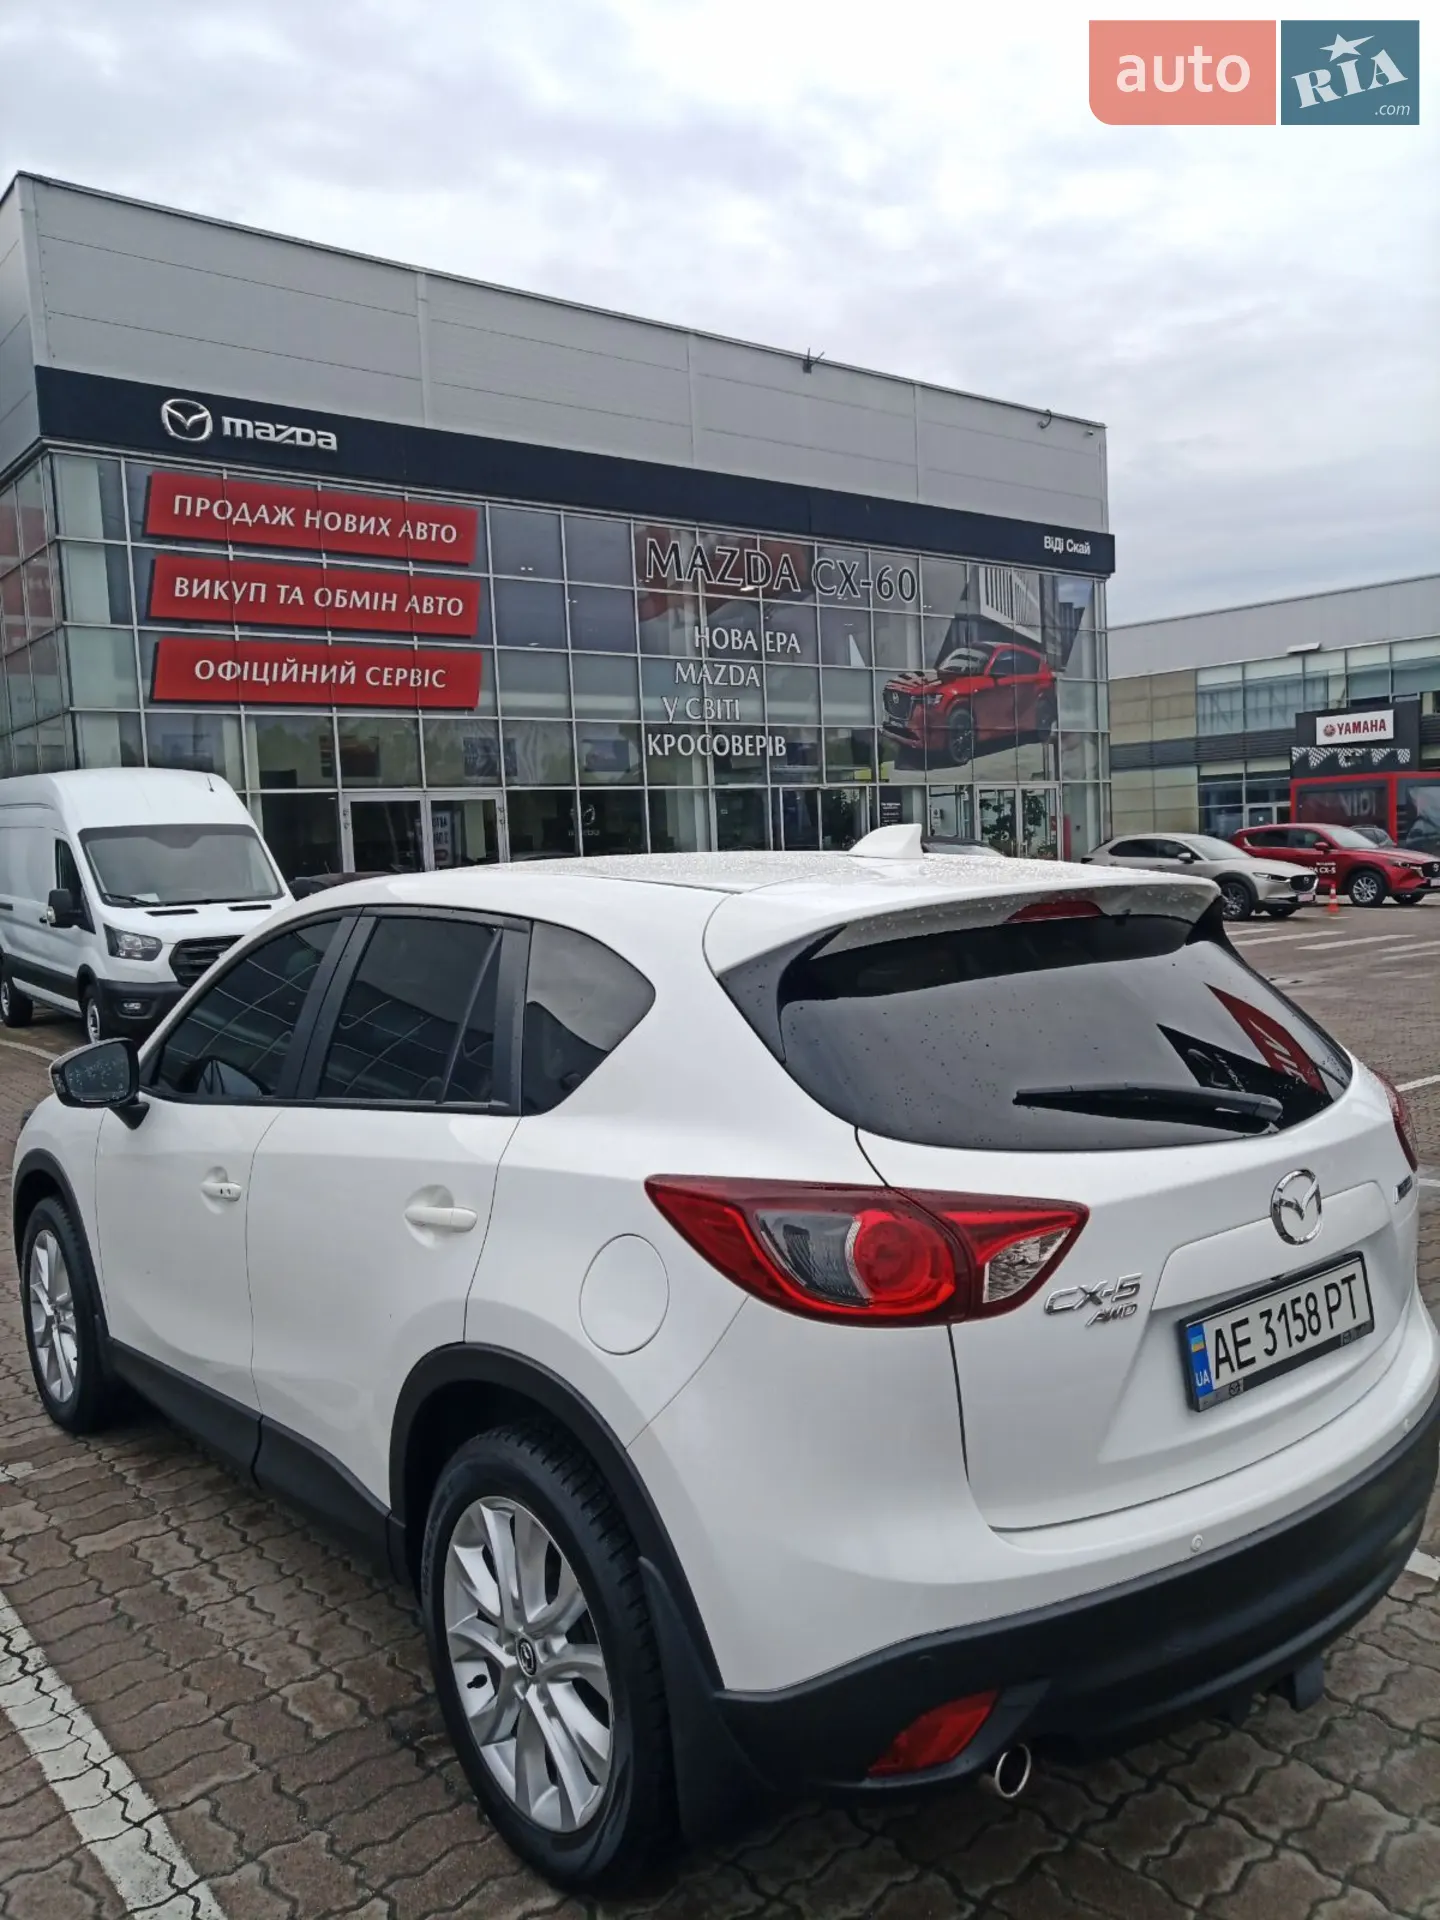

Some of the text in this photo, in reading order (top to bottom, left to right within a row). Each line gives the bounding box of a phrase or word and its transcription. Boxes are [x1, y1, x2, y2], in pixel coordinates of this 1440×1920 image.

[221, 415, 338, 451] mazda
[173, 494, 458, 544] ПРОДАЖ НОВИХ АВТО
[1066, 538, 1092, 556] Скай
[646, 537, 918, 603] MAZDA CX-60
[173, 576, 464, 617] ВИКУП ТА ОБМІН АВТО
[694, 625, 802, 654] НОВА ЕРА
[194, 656, 447, 689] ОФІЦІЙНИЙ СЕРВІС
[674, 661, 761, 688] MAZDA
[662, 695, 741, 723] У СВІТІ
[1337, 718, 1387, 736] YAMAHA
[647, 733, 788, 758] КРОСОВЕРІВ
[1044, 1272, 1142, 1316] CX-5
[1085, 1302, 1138, 1328] AWD
[1213, 1273, 1359, 1380] AE 3158 PT
[1195, 1371, 1211, 1387] UA
